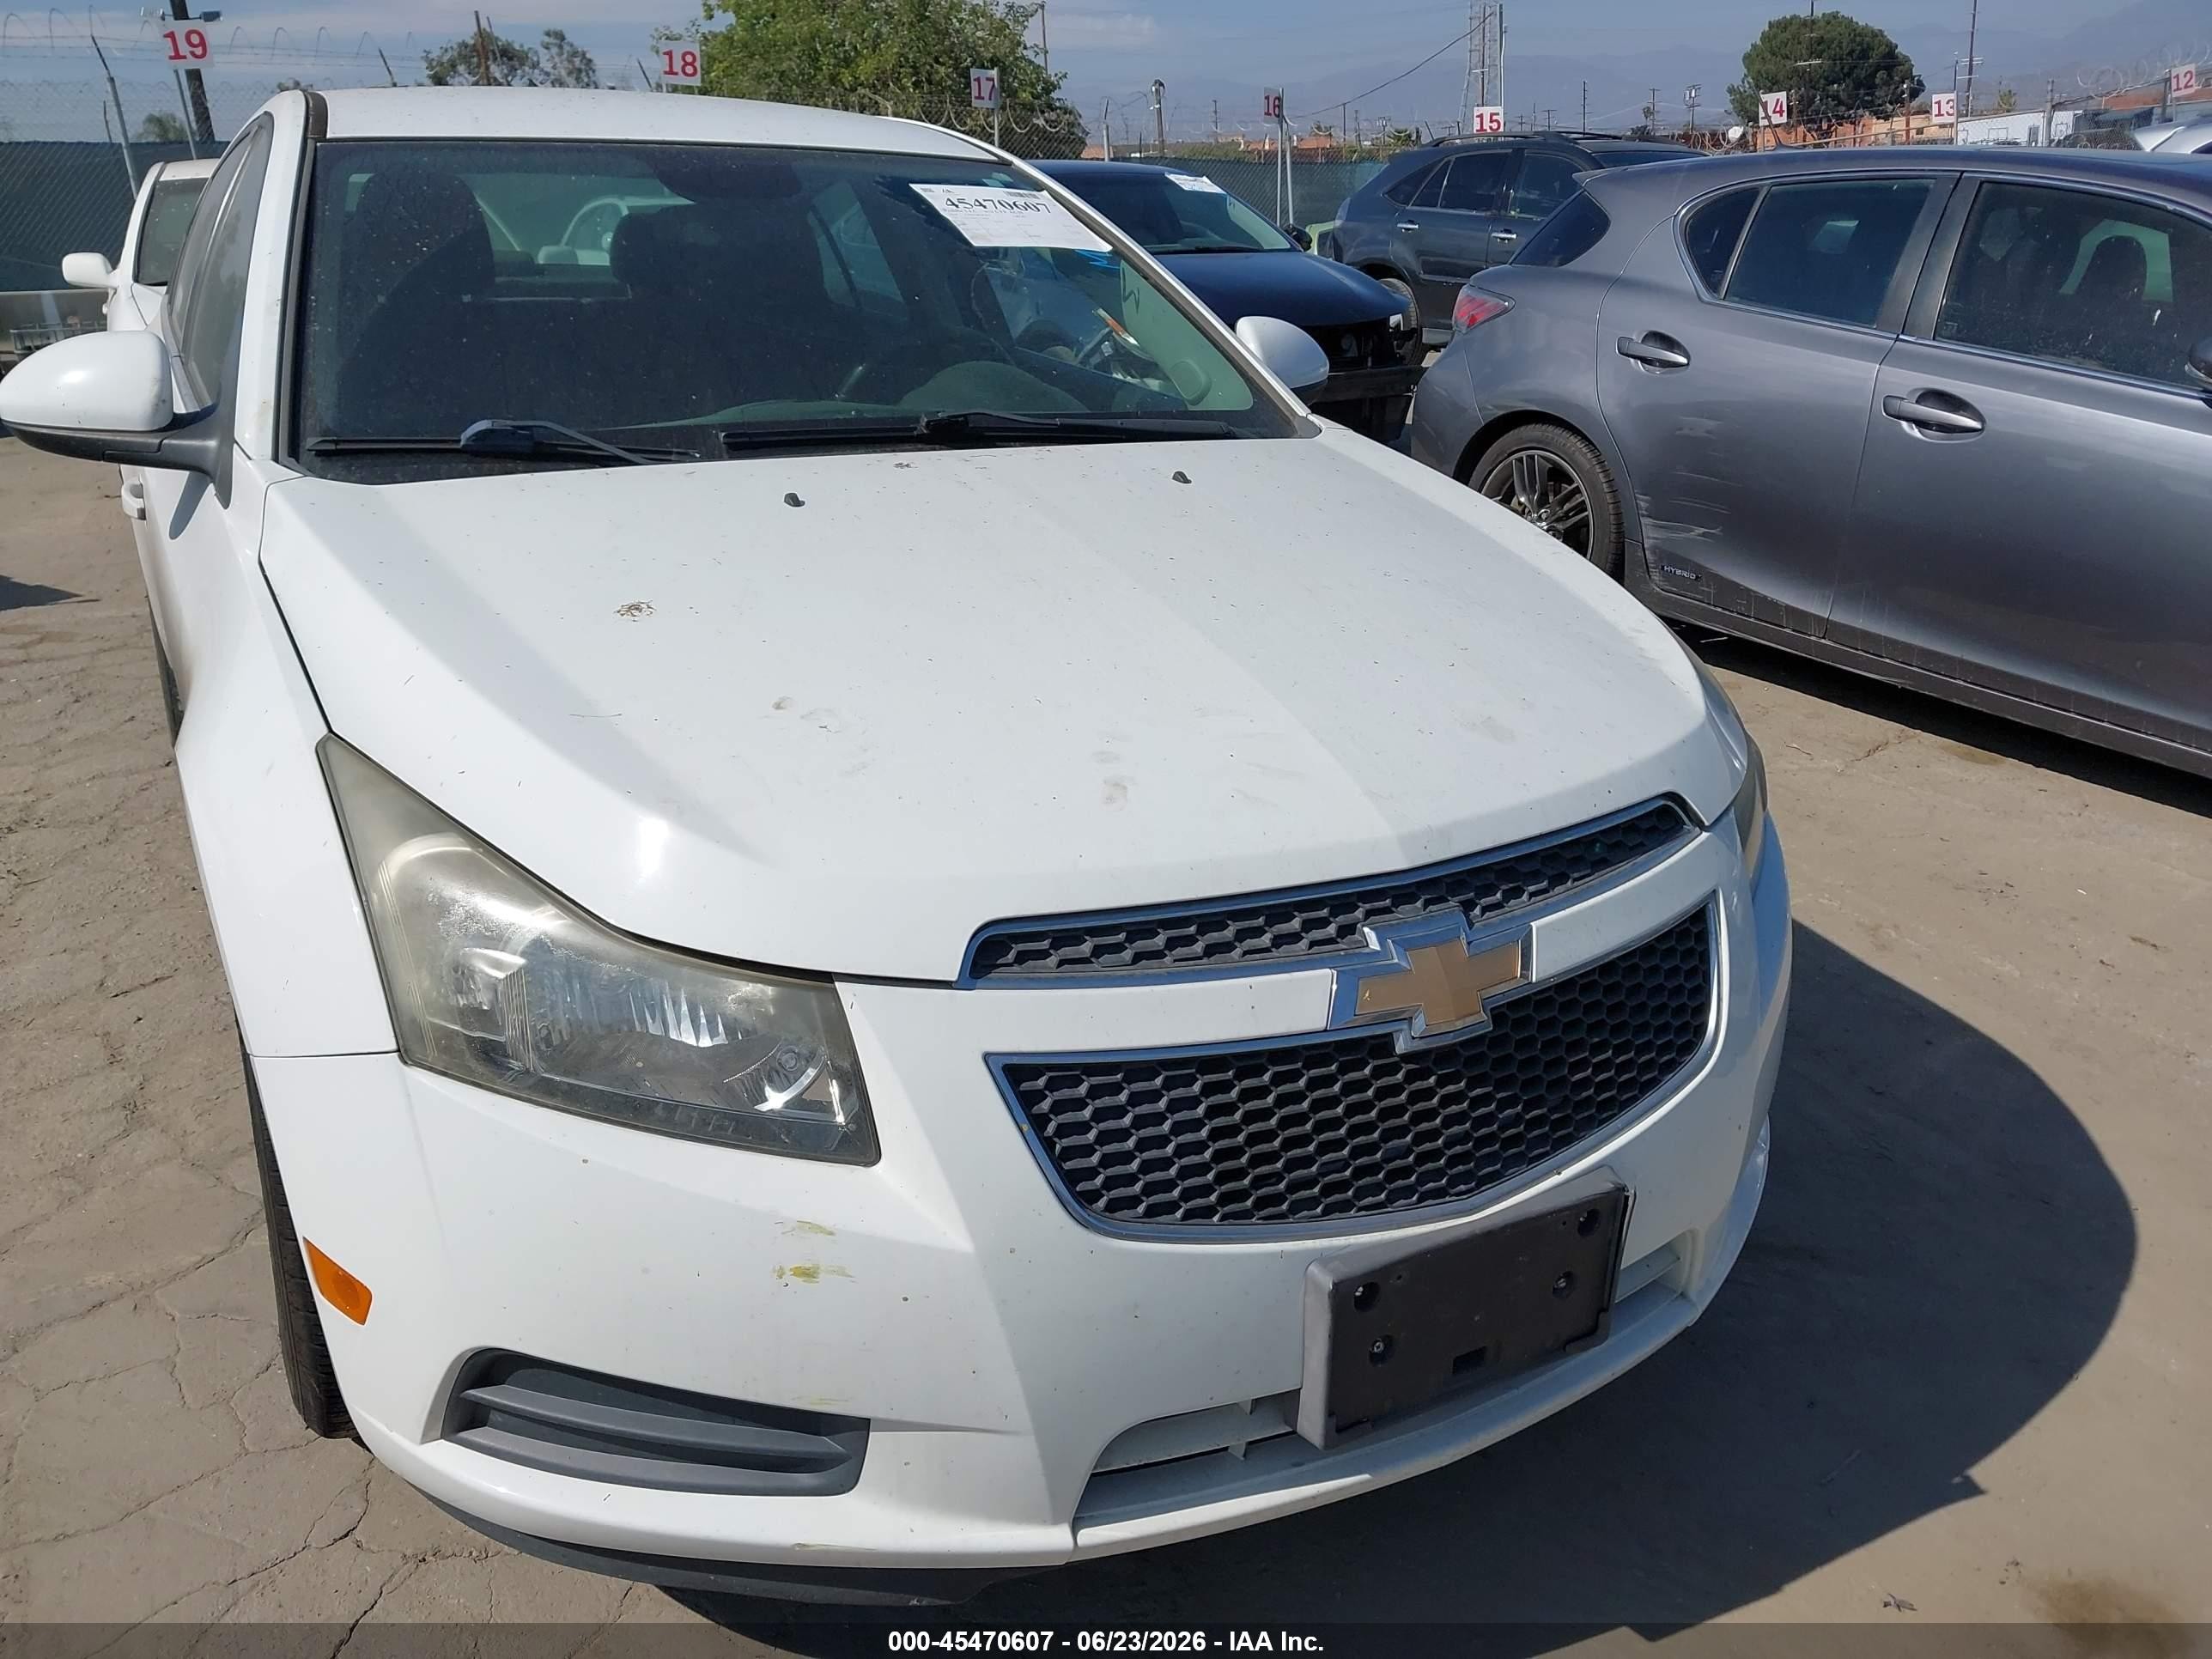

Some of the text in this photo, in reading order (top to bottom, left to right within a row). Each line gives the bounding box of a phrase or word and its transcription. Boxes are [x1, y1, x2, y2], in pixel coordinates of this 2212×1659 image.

[163, 29, 207, 60] 19
[662, 49, 698, 77] 18
[973, 76, 995, 101] 17
[2172, 70, 2194, 93] 12
[1264, 94, 1281, 118] 16
[1934, 99, 1955, 118] 13
[1475, 112, 1502, 132] 15
[945, 198, 1051, 214] 45470607
[1663, 565, 1697, 580] HYBRID
